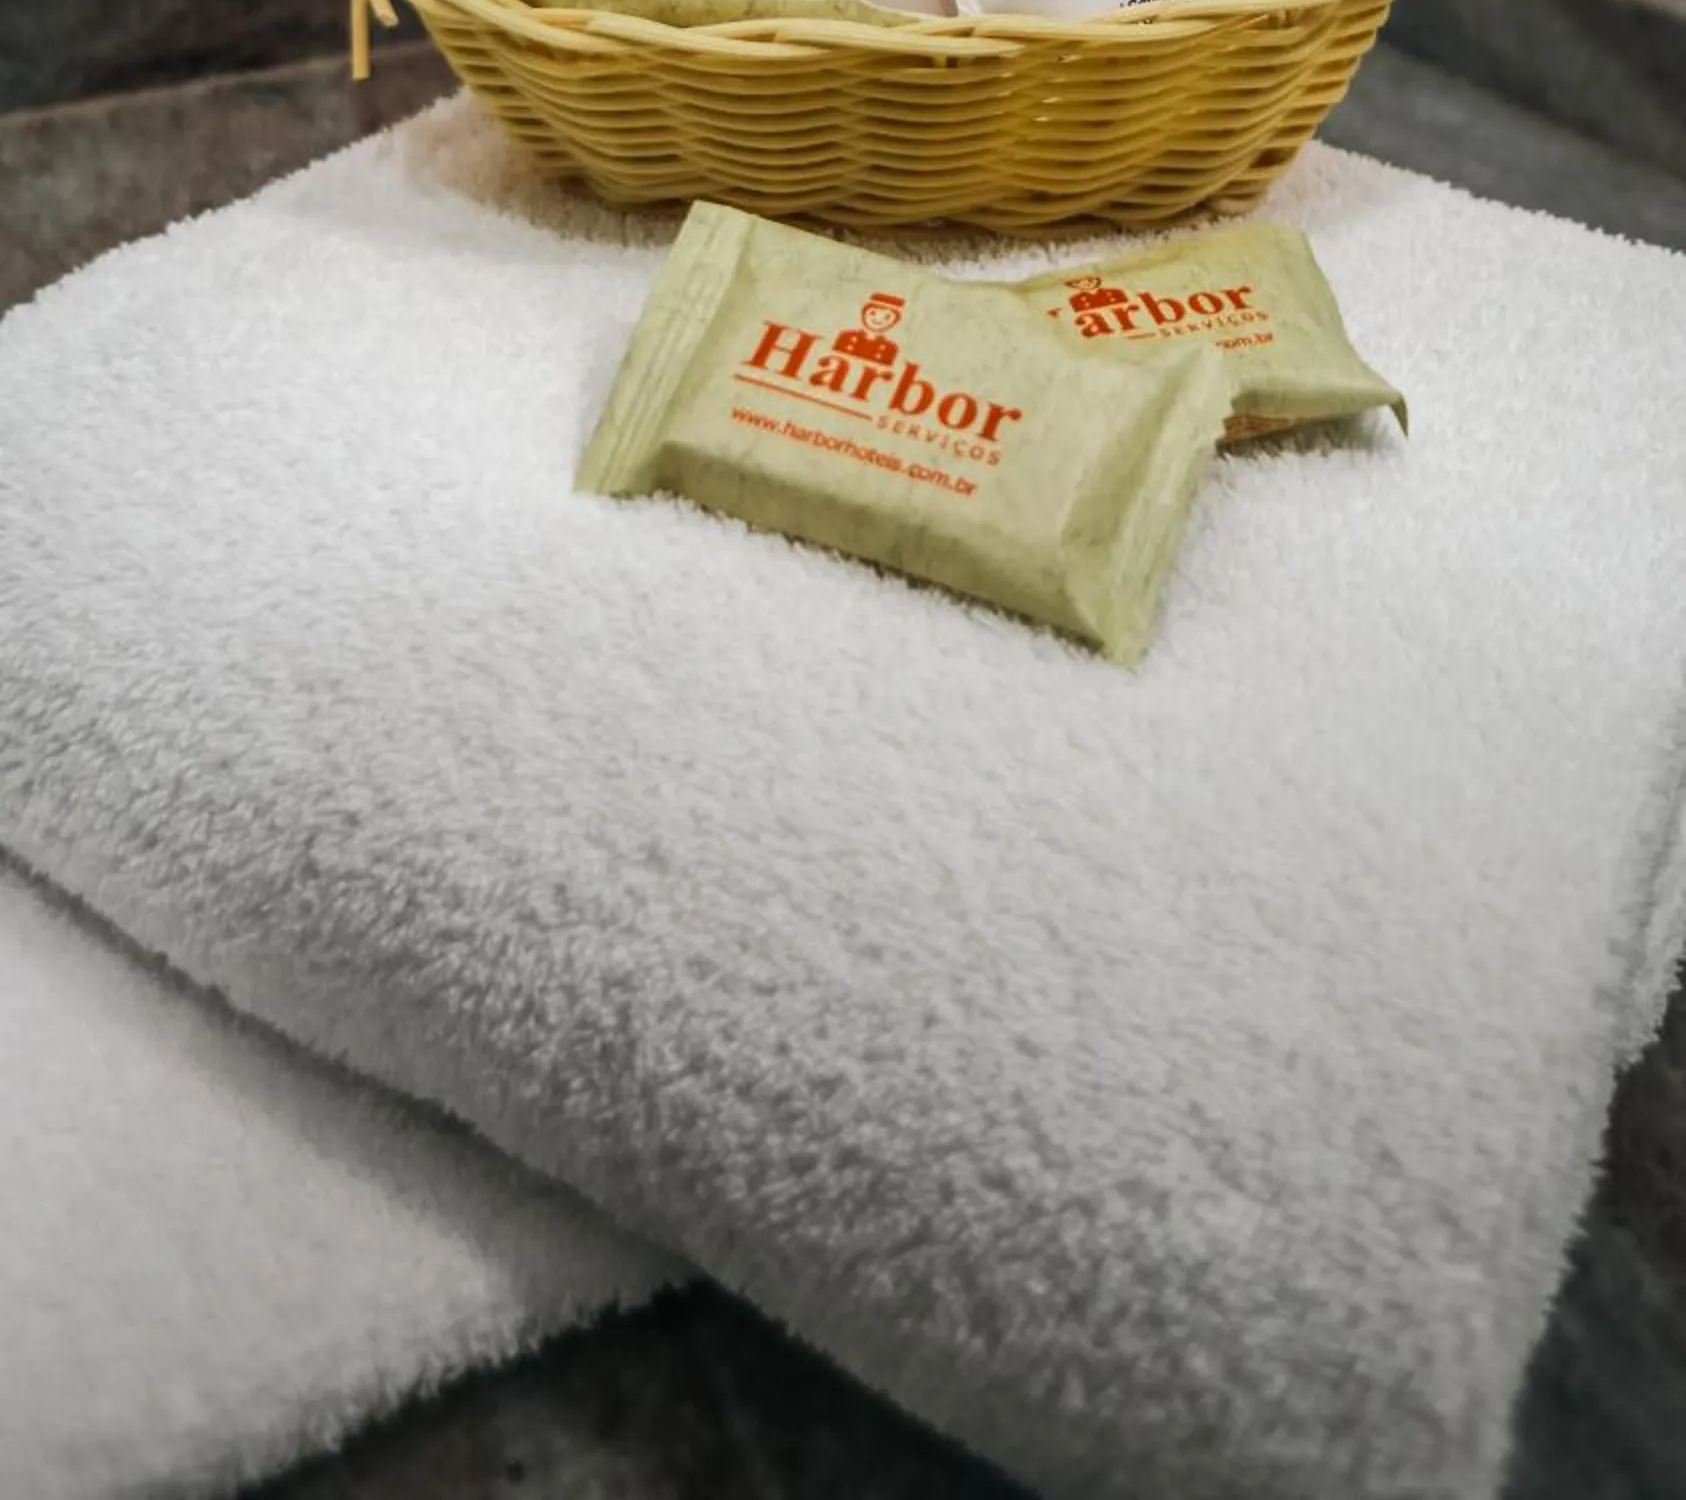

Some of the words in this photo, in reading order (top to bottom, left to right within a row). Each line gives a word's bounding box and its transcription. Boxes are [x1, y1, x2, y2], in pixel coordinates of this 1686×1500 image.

[1047, 285, 1252, 339] arbor
[741, 320, 1023, 442] Harbor
[876, 414, 1002, 467] SERVIÇOS
